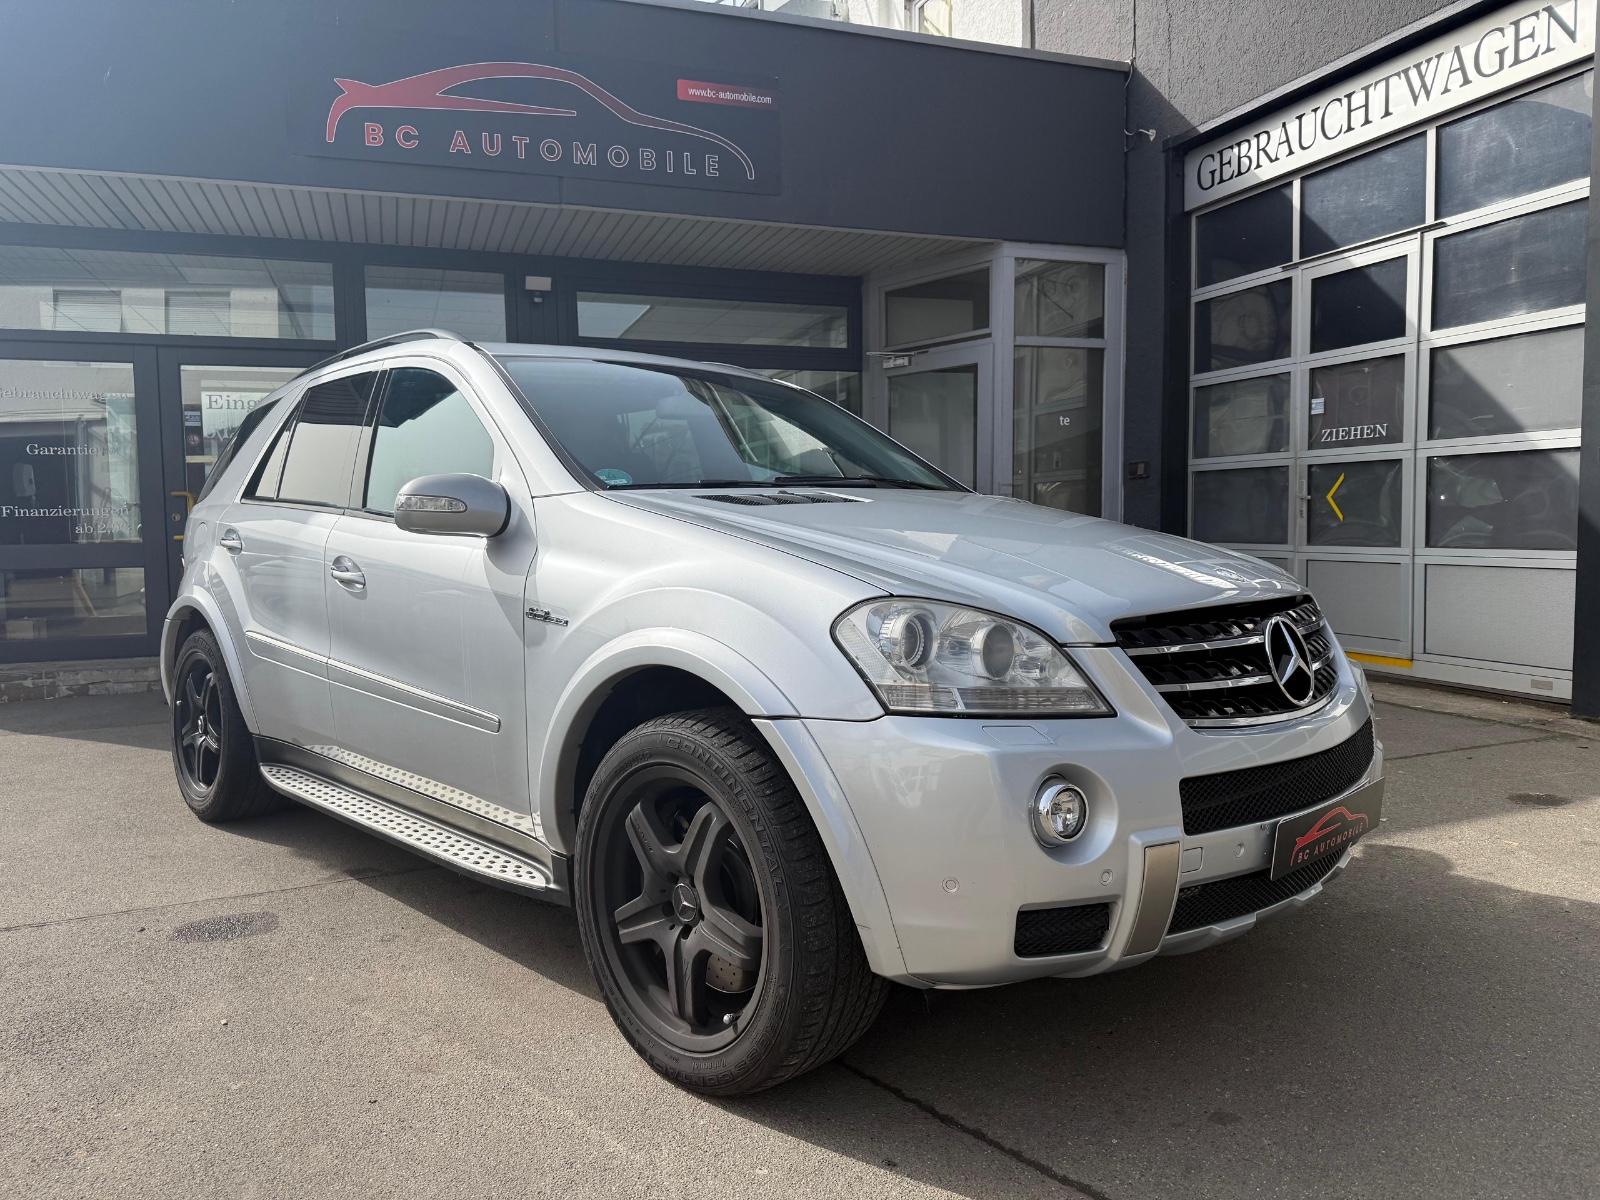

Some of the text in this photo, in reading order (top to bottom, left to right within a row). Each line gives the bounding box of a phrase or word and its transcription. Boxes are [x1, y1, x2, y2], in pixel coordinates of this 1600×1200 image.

[687, 88, 772, 104] www.bc-automobile.com
[1196, 0, 1578, 191] GEBRAUCHTWAGEN
[364, 122, 719, 177] BC AUTOMOBILE
[1060, 416, 1070, 426] te
[1321, 424, 1388, 442] ZIEHEN
[75, 523, 94, 534] ab
[1298, 822, 1363, 863] BC AUTOMOBILE
